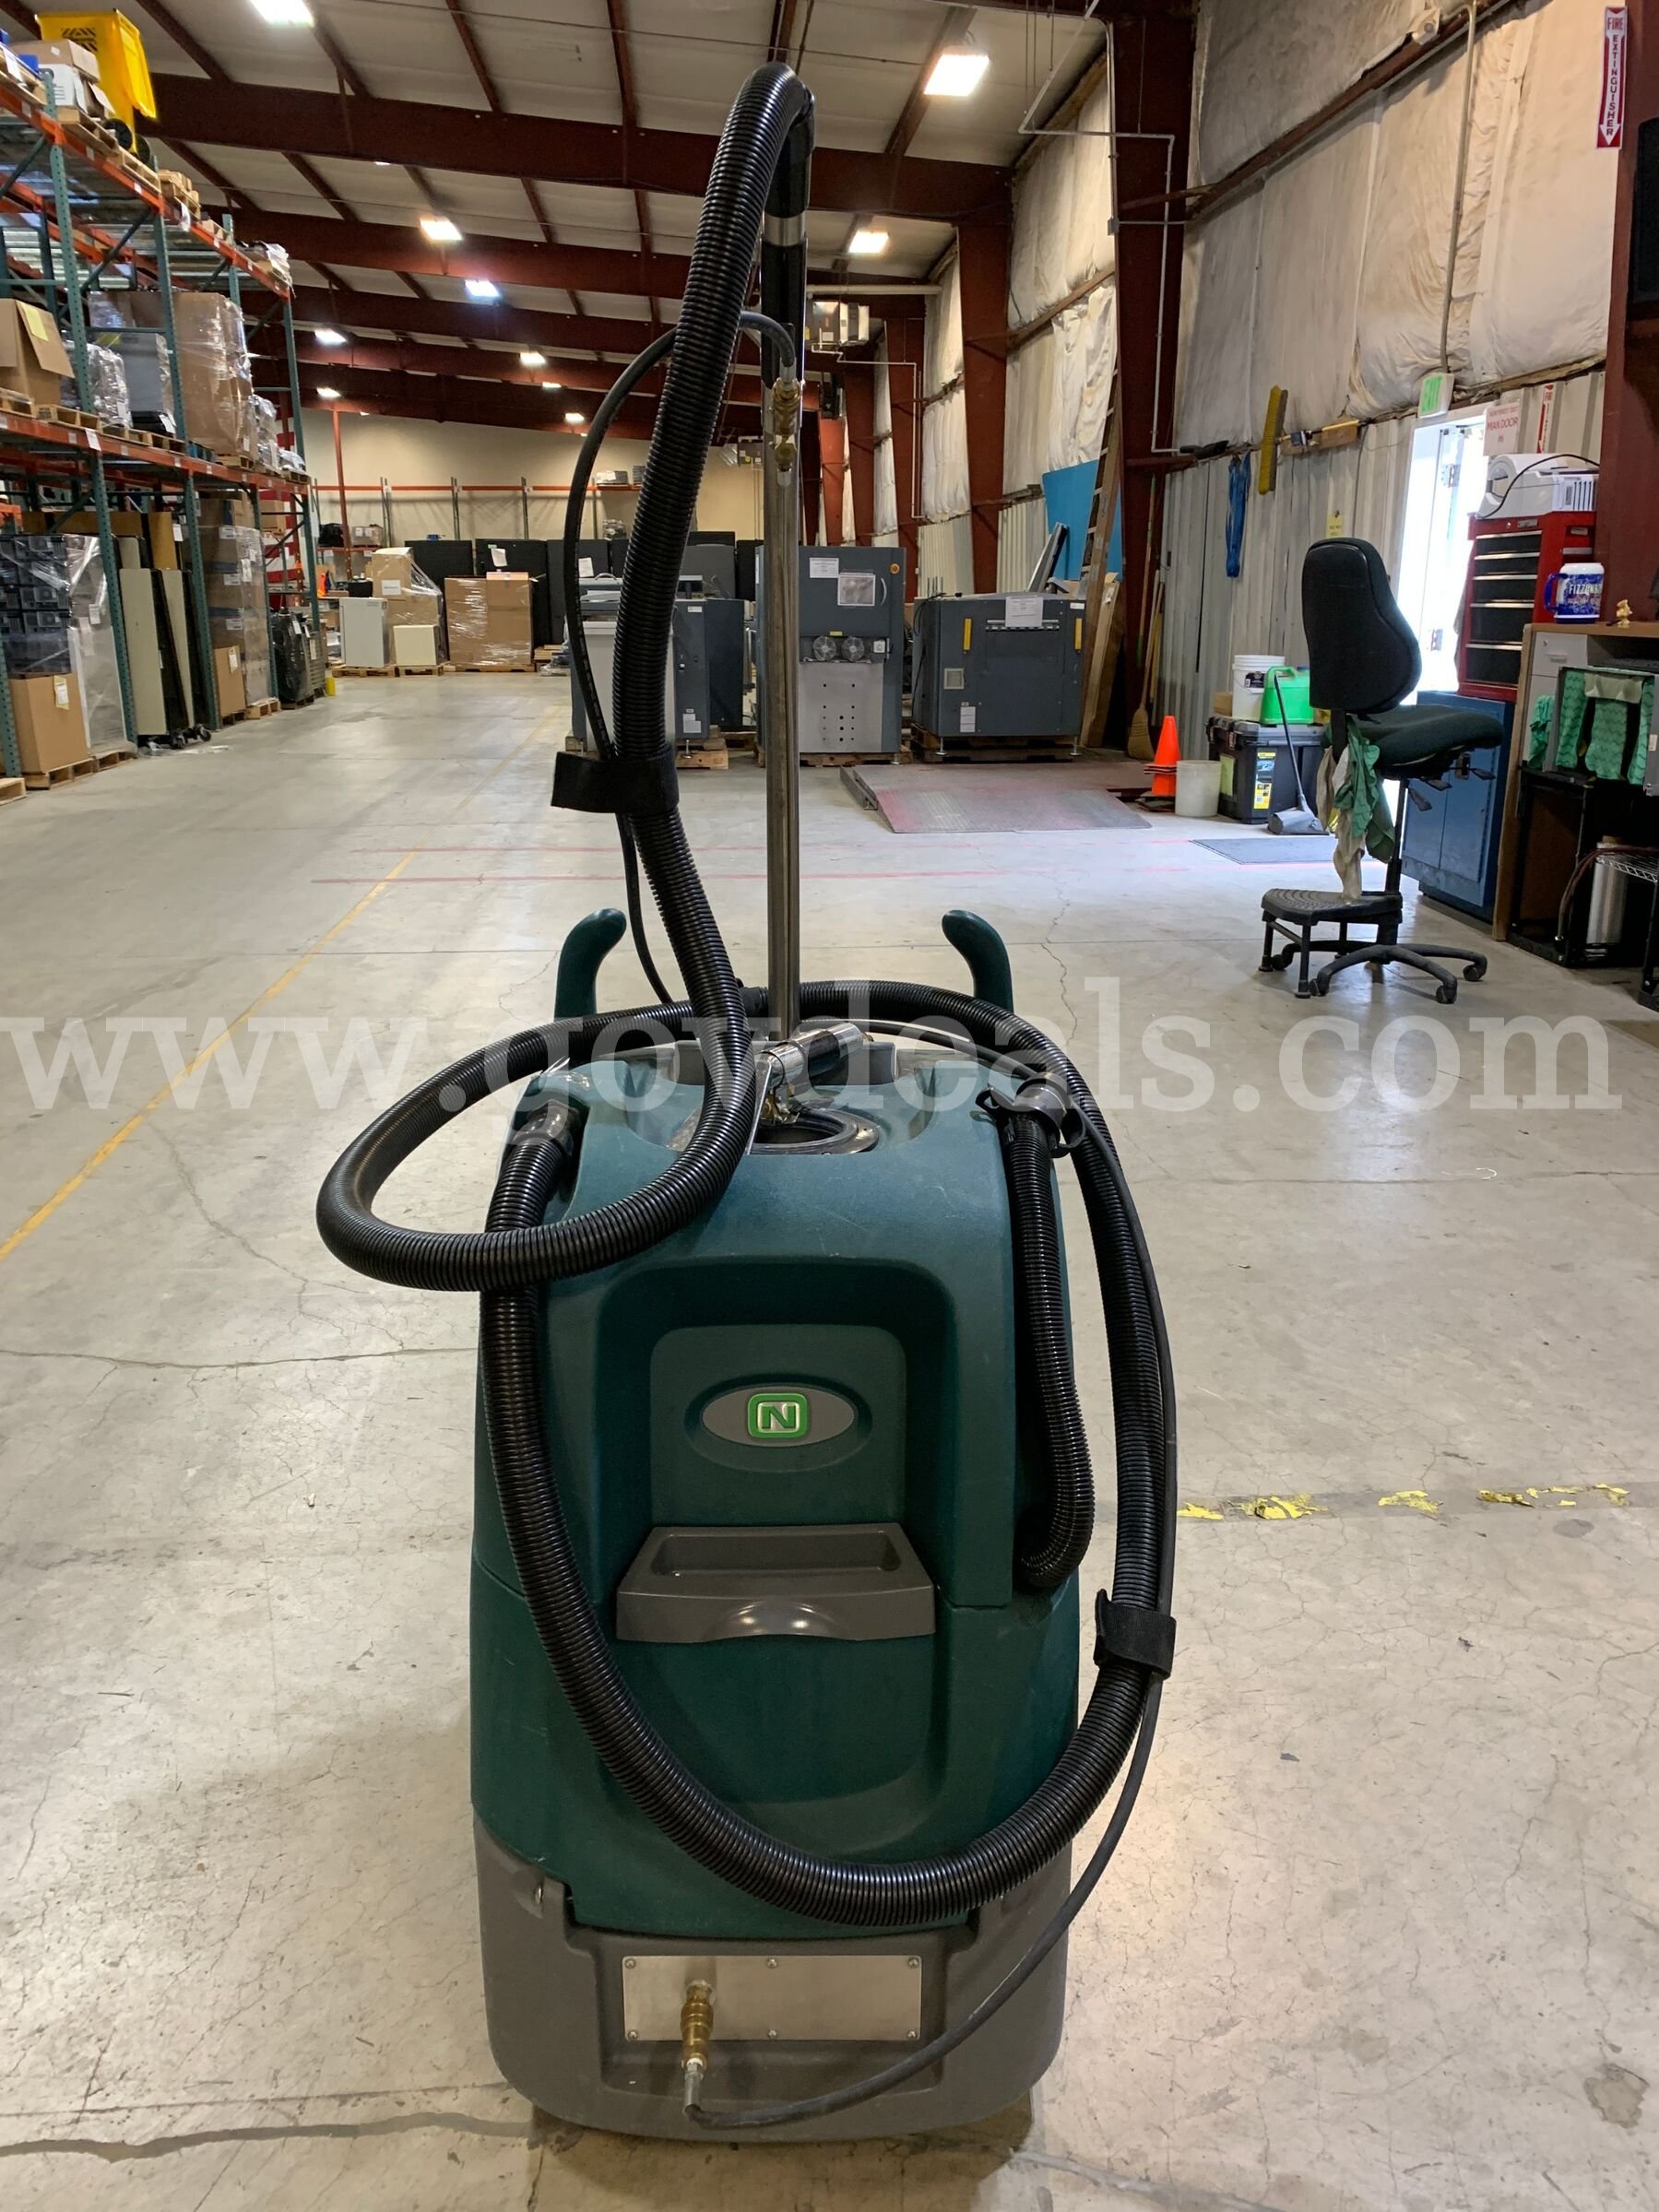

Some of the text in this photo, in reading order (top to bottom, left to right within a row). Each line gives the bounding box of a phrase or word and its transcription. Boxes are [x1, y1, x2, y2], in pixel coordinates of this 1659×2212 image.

[1607, 18, 1624, 30] FIRE
[1606, 34, 1619, 136] EXTINGUISHER
[1487, 417, 1519, 432] MAN DOOR
